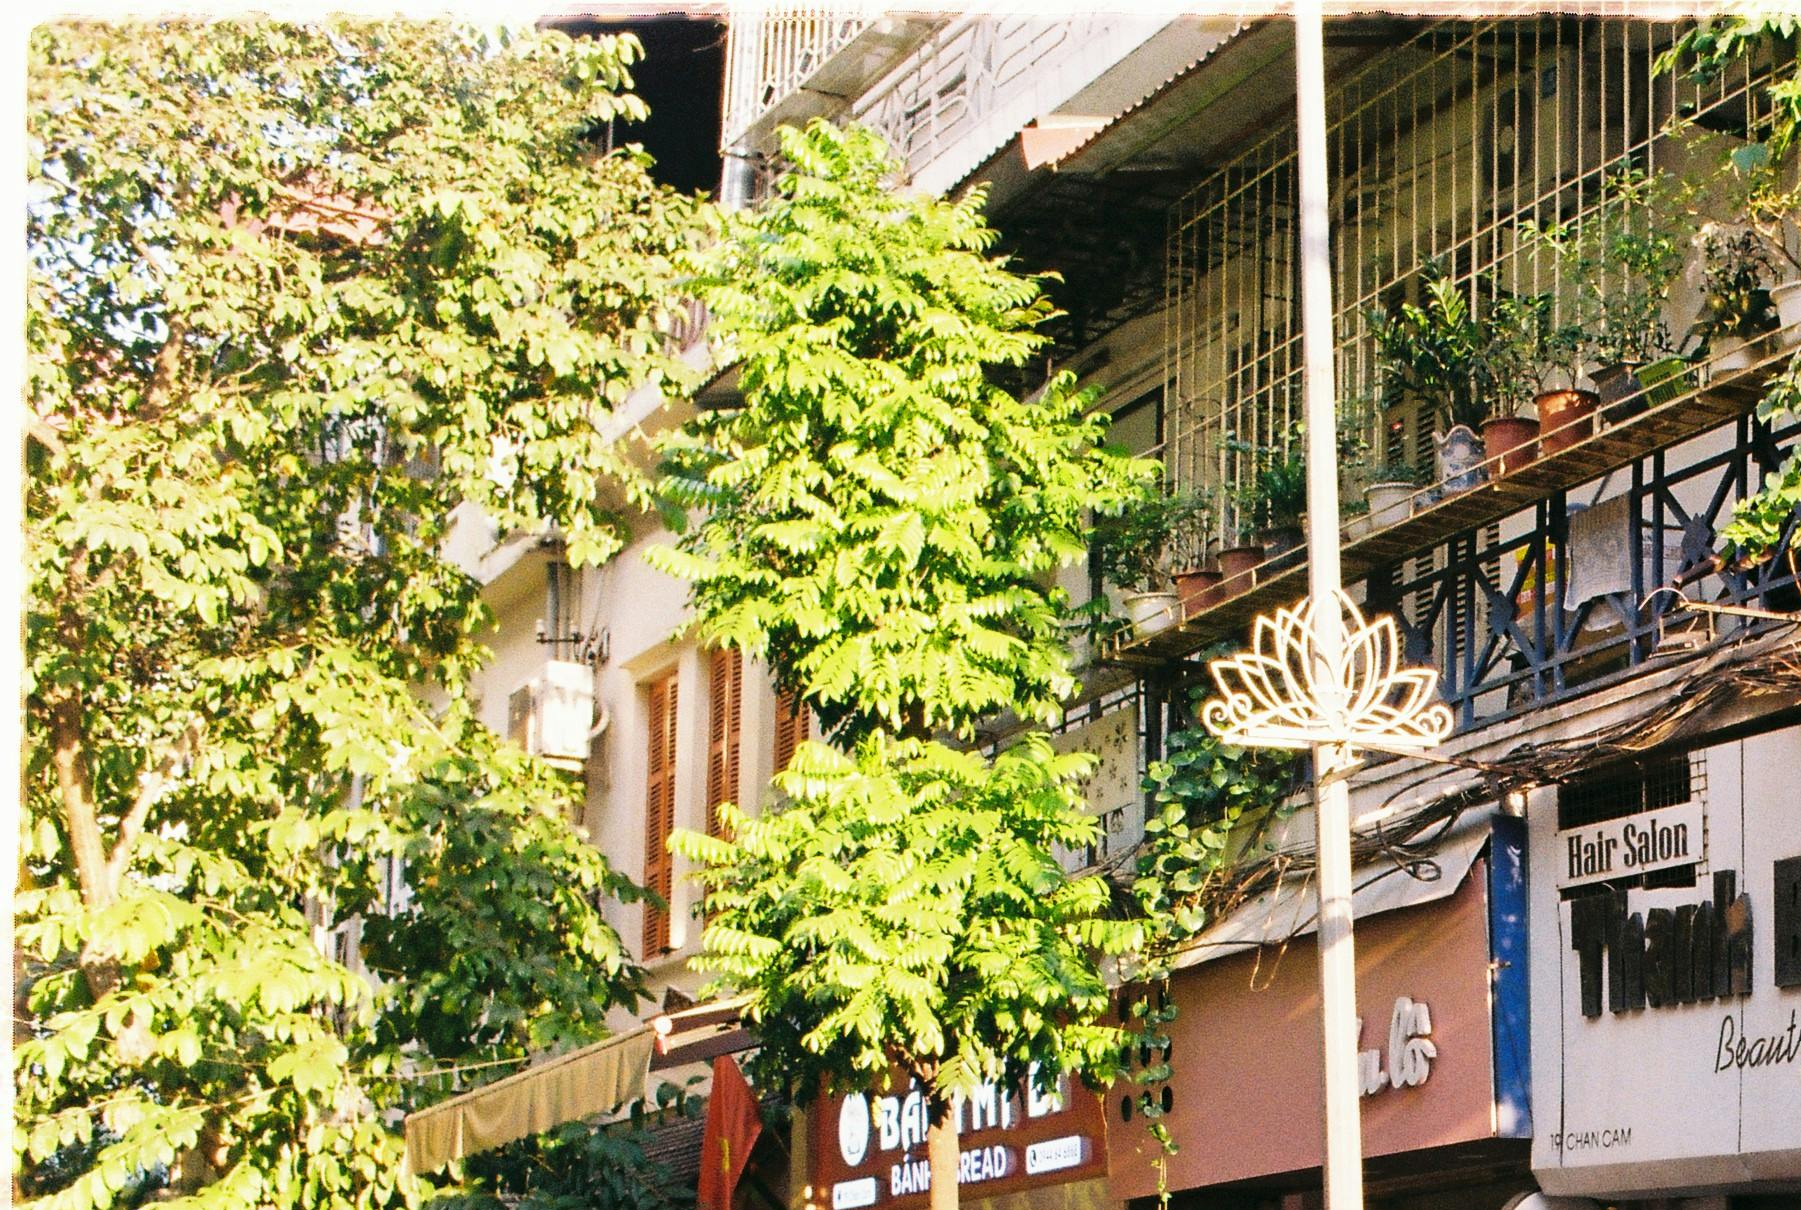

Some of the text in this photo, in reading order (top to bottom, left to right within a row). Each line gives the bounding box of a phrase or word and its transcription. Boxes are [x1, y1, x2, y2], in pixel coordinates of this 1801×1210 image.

[1567, 819, 1689, 879] Hair Salon
[1571, 869, 1754, 1017] Thanh
[880, 1077, 962, 1150] BÁ
[1566, 1131, 1599, 1150] CHAN
[1602, 1127, 1632, 1147] CAM
